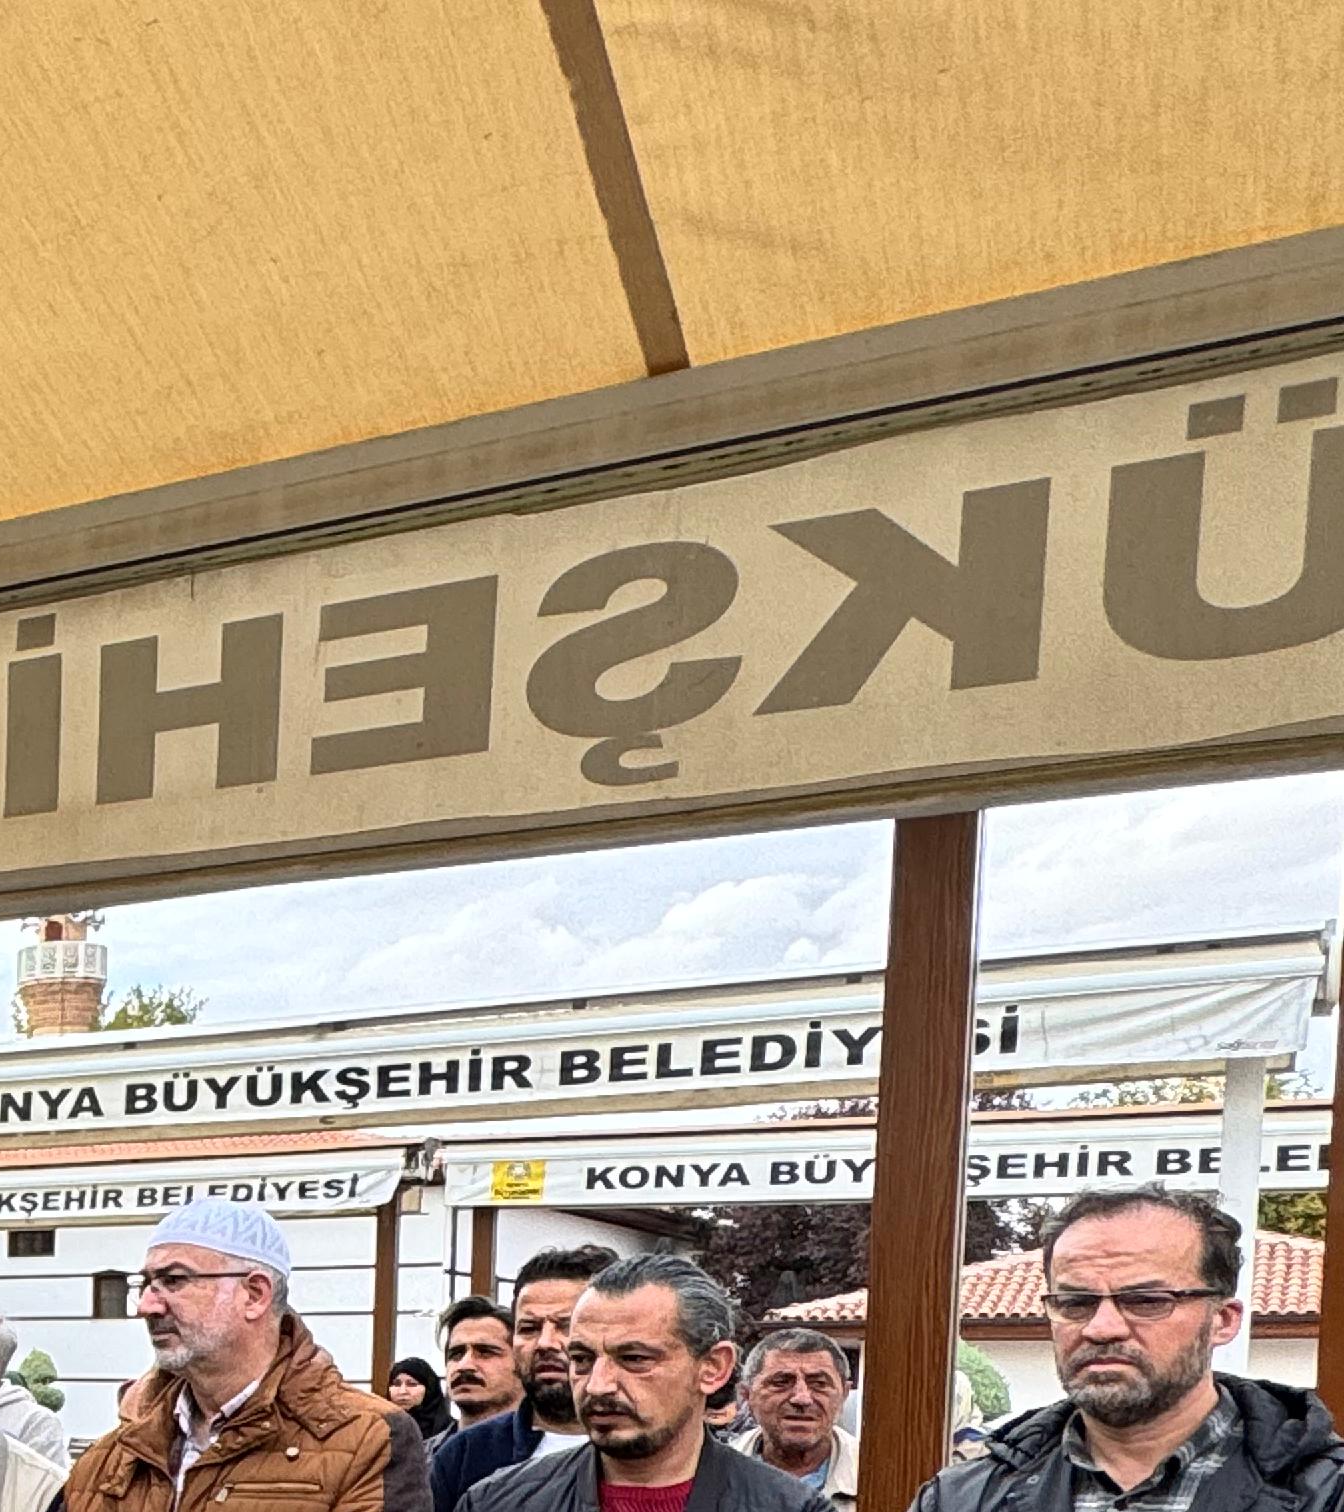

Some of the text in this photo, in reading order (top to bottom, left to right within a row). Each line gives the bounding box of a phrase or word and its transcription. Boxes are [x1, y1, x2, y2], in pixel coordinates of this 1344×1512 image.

[123, 1045, 533, 1117] BÜYÜKŞEHİR
[558, 1004, 1020, 1087] BELEDİYİ
[585, 1161, 752, 1192] KONYA
[769, 1144, 1133, 1187] BÜYŞEHİR
